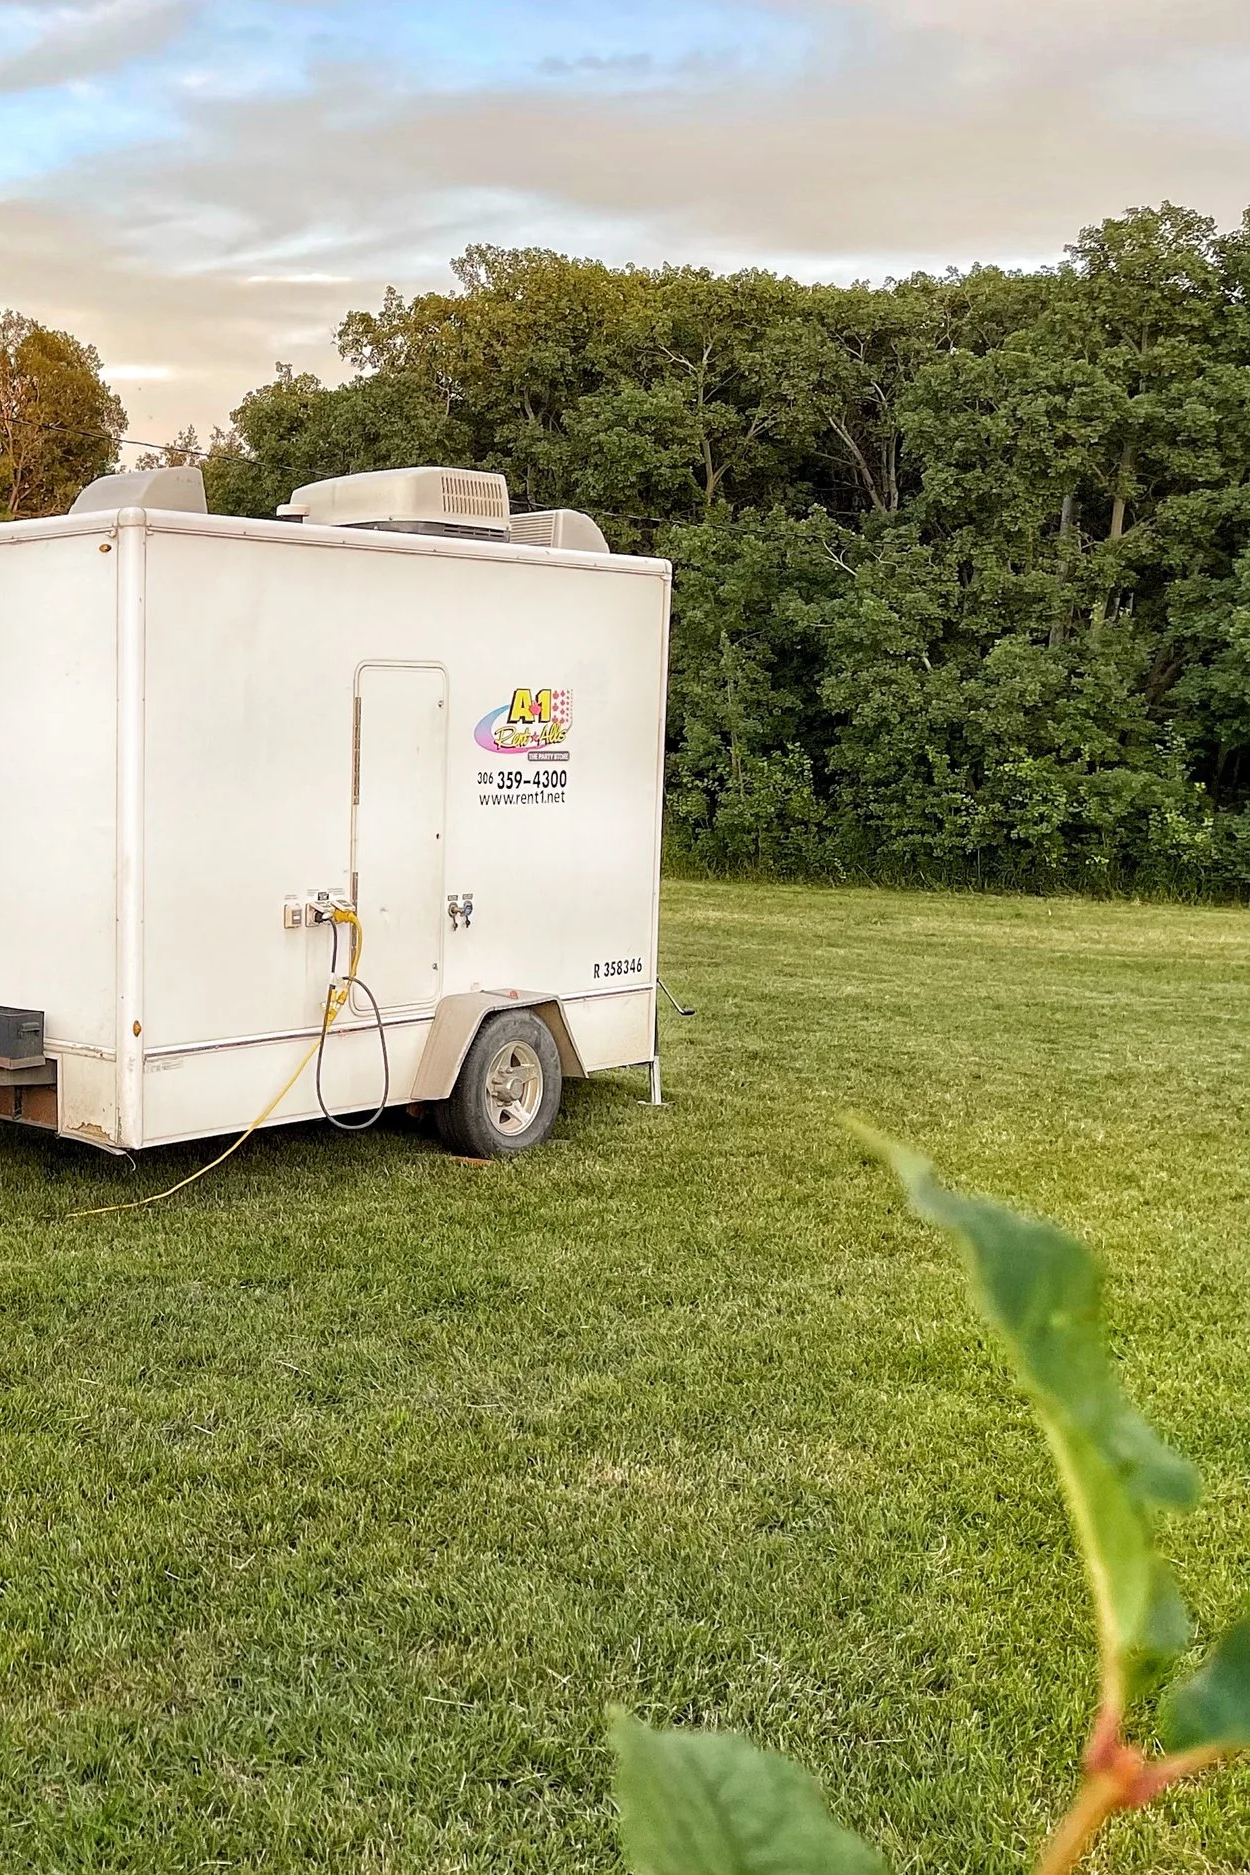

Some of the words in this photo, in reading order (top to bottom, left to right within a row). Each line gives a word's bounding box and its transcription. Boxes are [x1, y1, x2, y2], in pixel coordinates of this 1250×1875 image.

[493, 725, 530, 750] Rent
[477, 772, 493, 785] 306
[497, 770, 567, 789] 359-4300
[479, 790, 565, 805] www.rent1.net
[593, 963, 600, 979] R
[604, 957, 642, 977] 358346
